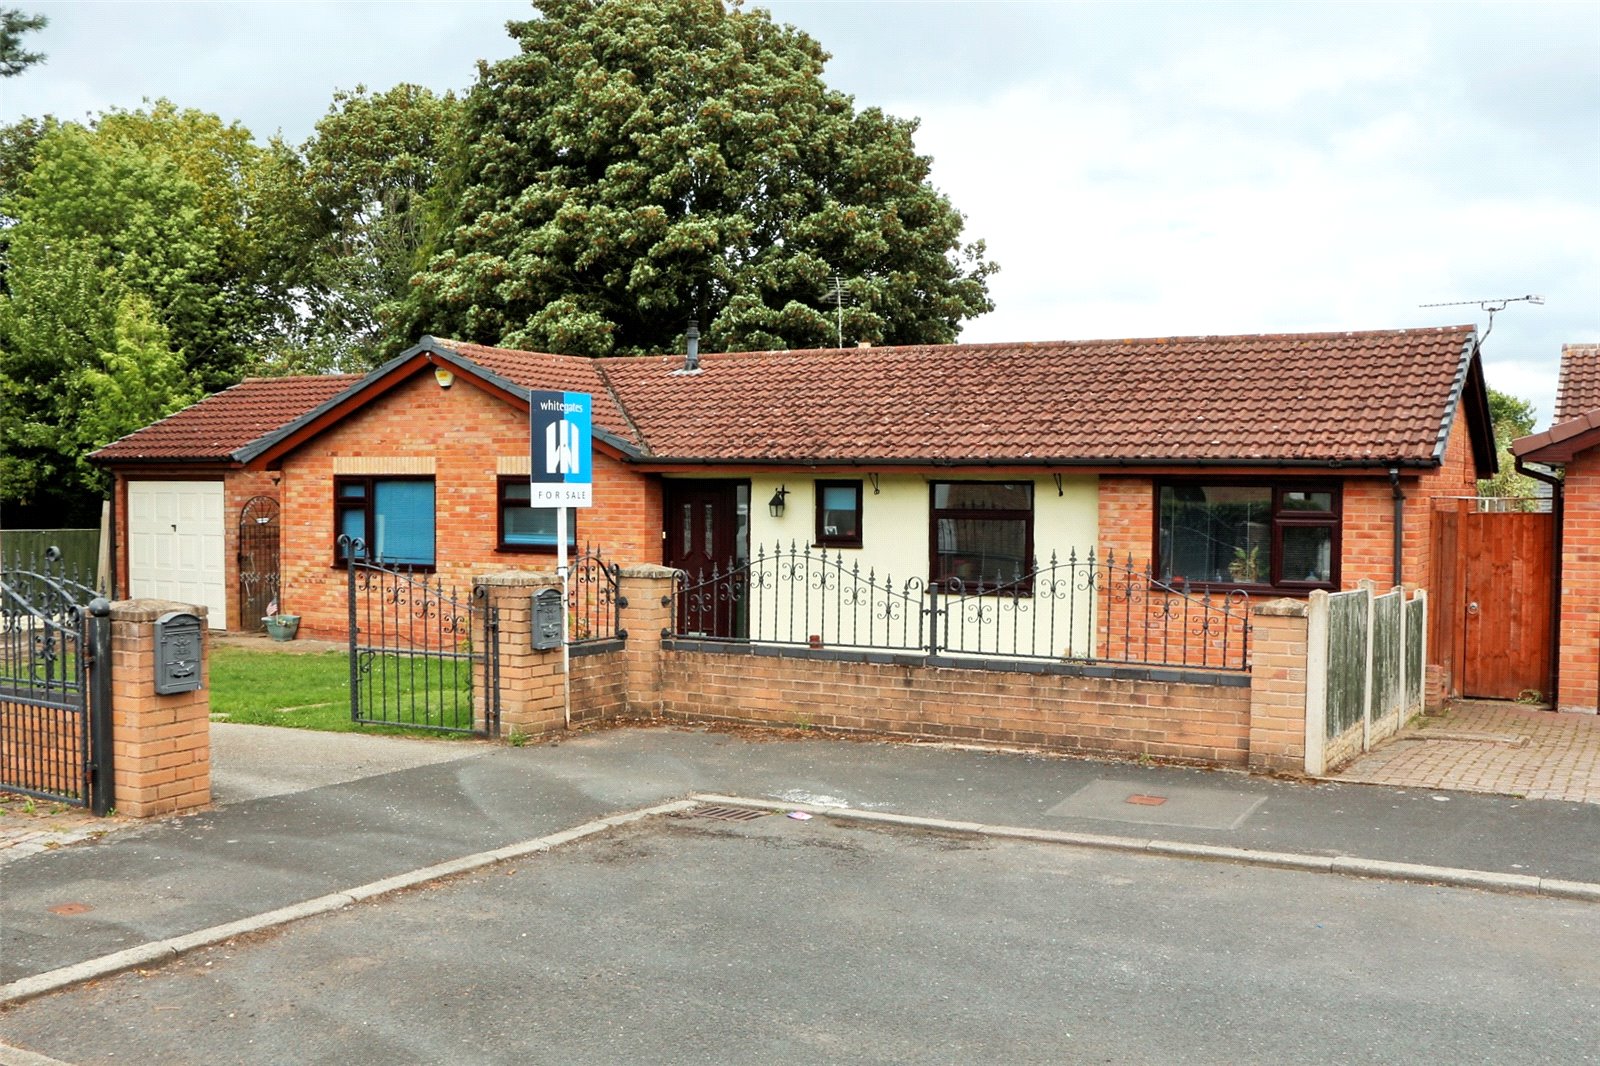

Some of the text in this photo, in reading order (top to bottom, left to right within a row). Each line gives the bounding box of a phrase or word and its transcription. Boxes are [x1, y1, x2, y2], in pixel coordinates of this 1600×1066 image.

[540, 399, 583, 414] whitegates
[538, 491, 586, 500] FOR SALE
